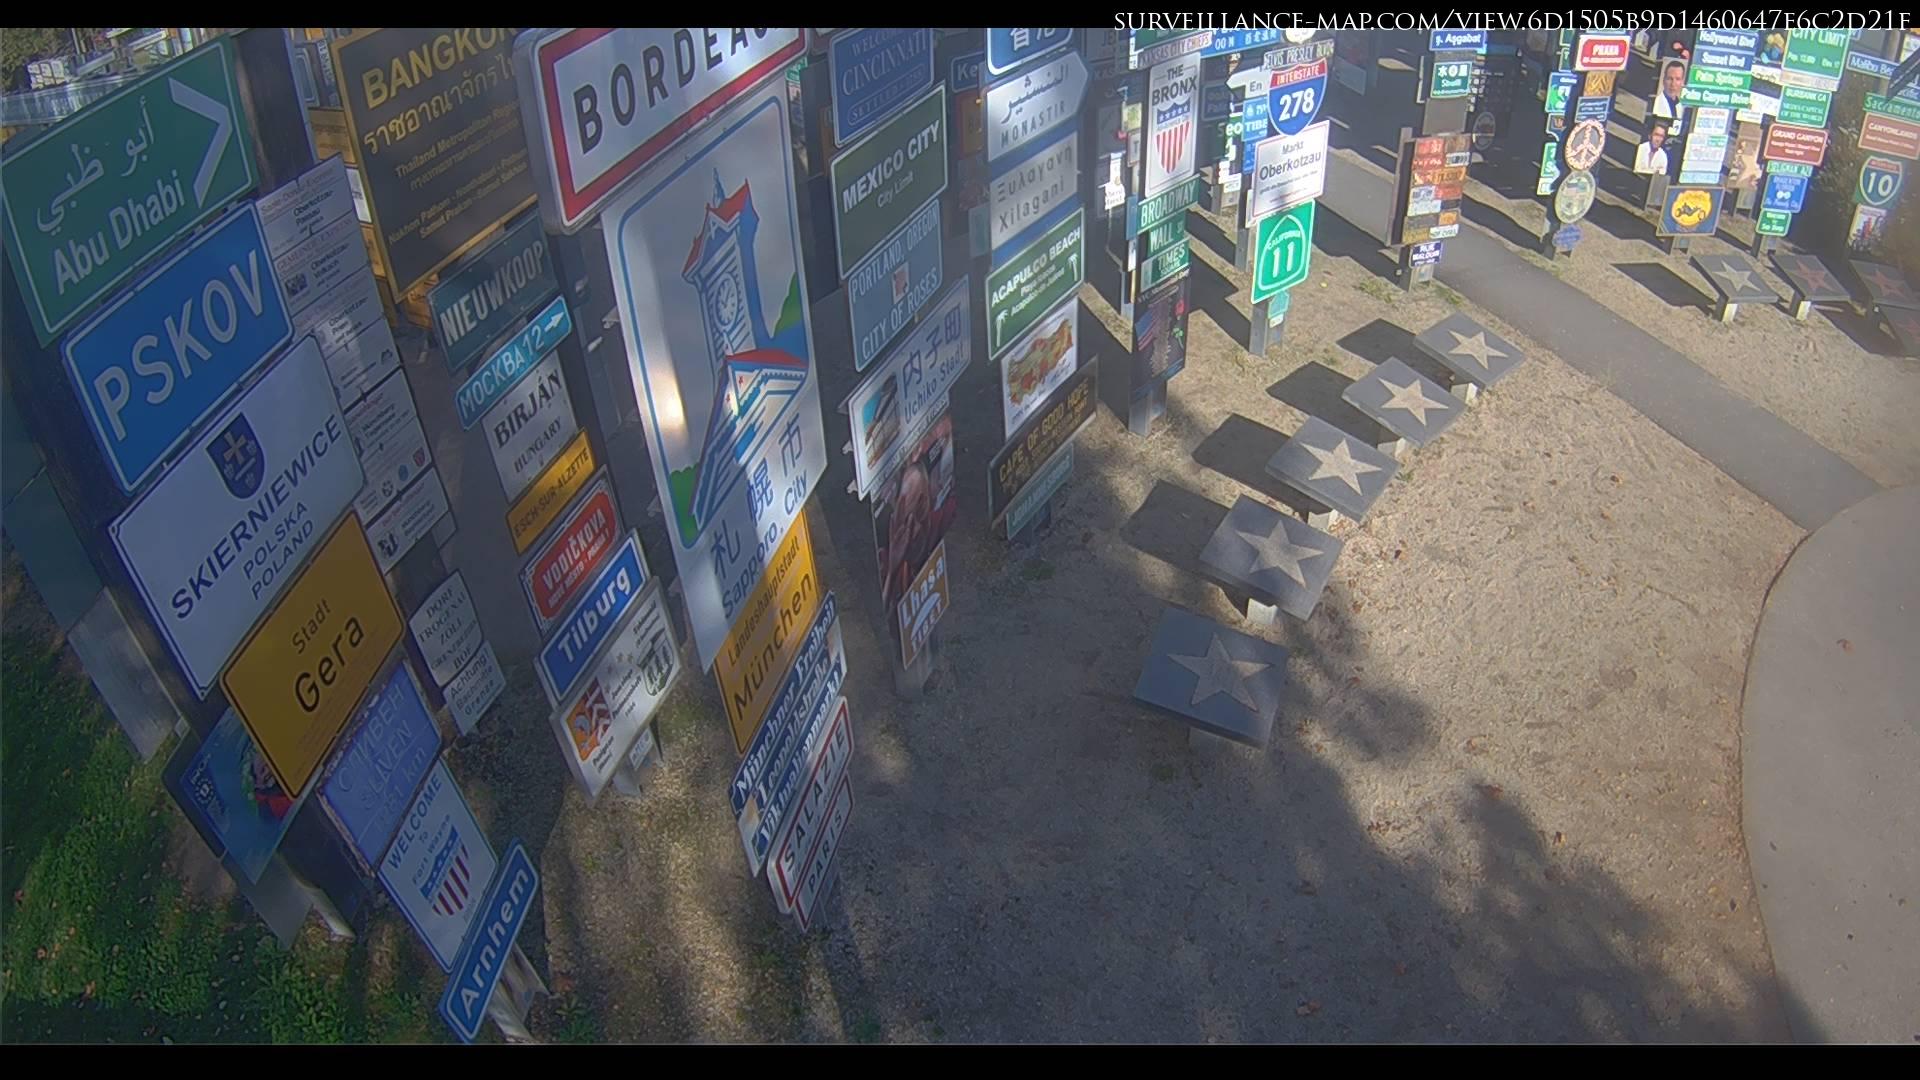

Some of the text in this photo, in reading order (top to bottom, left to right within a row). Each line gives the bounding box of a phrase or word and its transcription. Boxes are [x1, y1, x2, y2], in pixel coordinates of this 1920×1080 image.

[1166, 64, 1184, 80] THE
[1276, 65, 1320, 85] INTERSTATE
[1817, 30, 1846, 48] LIMIT
[363, 54, 514, 154] ราชอาณาจักรไ
[1152, 75, 1198, 107] BRONX
[1278, 87, 1315, 121] 278
[36, 96, 155, 235] أبو ظبي
[842, 119, 940, 214] MEXICO CITY
[1141, 180, 1196, 228] BROADWAY
[1260, 151, 1321, 180] Oberkotzau
[1868, 171, 1893, 197] 10
[53, 231, 110, 294] Abu
[109, 169, 186, 249] Dhabi
[906, 206, 938, 251] OREGON
[992, 253, 1047, 307] ACAPULCO
[1050, 227, 1080, 261] BEACH
[1150, 223, 1174, 253] WALL
[1158, 244, 1185, 271] TIMES
[1273, 241, 1295, 278] 11
[440, 239, 545, 347] NIEUWKOOP
[862, 267, 937, 360] CITY OF ROSES
[94, 249, 264, 441] PSKOV
[459, 345, 524, 420] МОСКВА
[522, 323, 545, 361] 12
[904, 377, 937, 424] Uchiko
[513, 416, 564, 474] HUNGARY
[1001, 444, 1024, 482] CAPE
[1027, 429, 1039, 450] OF
[1041, 403, 1065, 436] GOOD
[171, 414, 343, 619] SKIERNIEWICE
[513, 447, 589, 538] ESCH-SUR-ALZETTE
[710, 412, 803, 580] 札幌市
[784, 469, 808, 516] City
[242, 502, 308, 580] POLSKA
[251, 520, 313, 601] POLAND
[542, 508, 607, 590] VODIČKOVA
[292, 598, 331, 654] Stadt
[557, 567, 632, 664] Tilburg
[728, 536, 800, 667] Landeshauptstadt
[901, 555, 944, 628] Lhasa
[911, 601, 943, 652] TIBET
[294, 616, 365, 713] Gera
[450, 648, 491, 698] Achtung!
[734, 573, 812, 721] München
[736, 600, 836, 800] Münchner Freiheit
[756, 652, 830, 804] Leopoldstraße
[760, 666, 842, 843] Viktualienmarkt
[390, 775, 441, 869] WELCOME
[784, 727, 845, 874] SALAZIE
[412, 813, 452, 886] Fort Wayne
[807, 811, 842, 896] PARIS
[460, 867, 531, 1019] Arnhem
